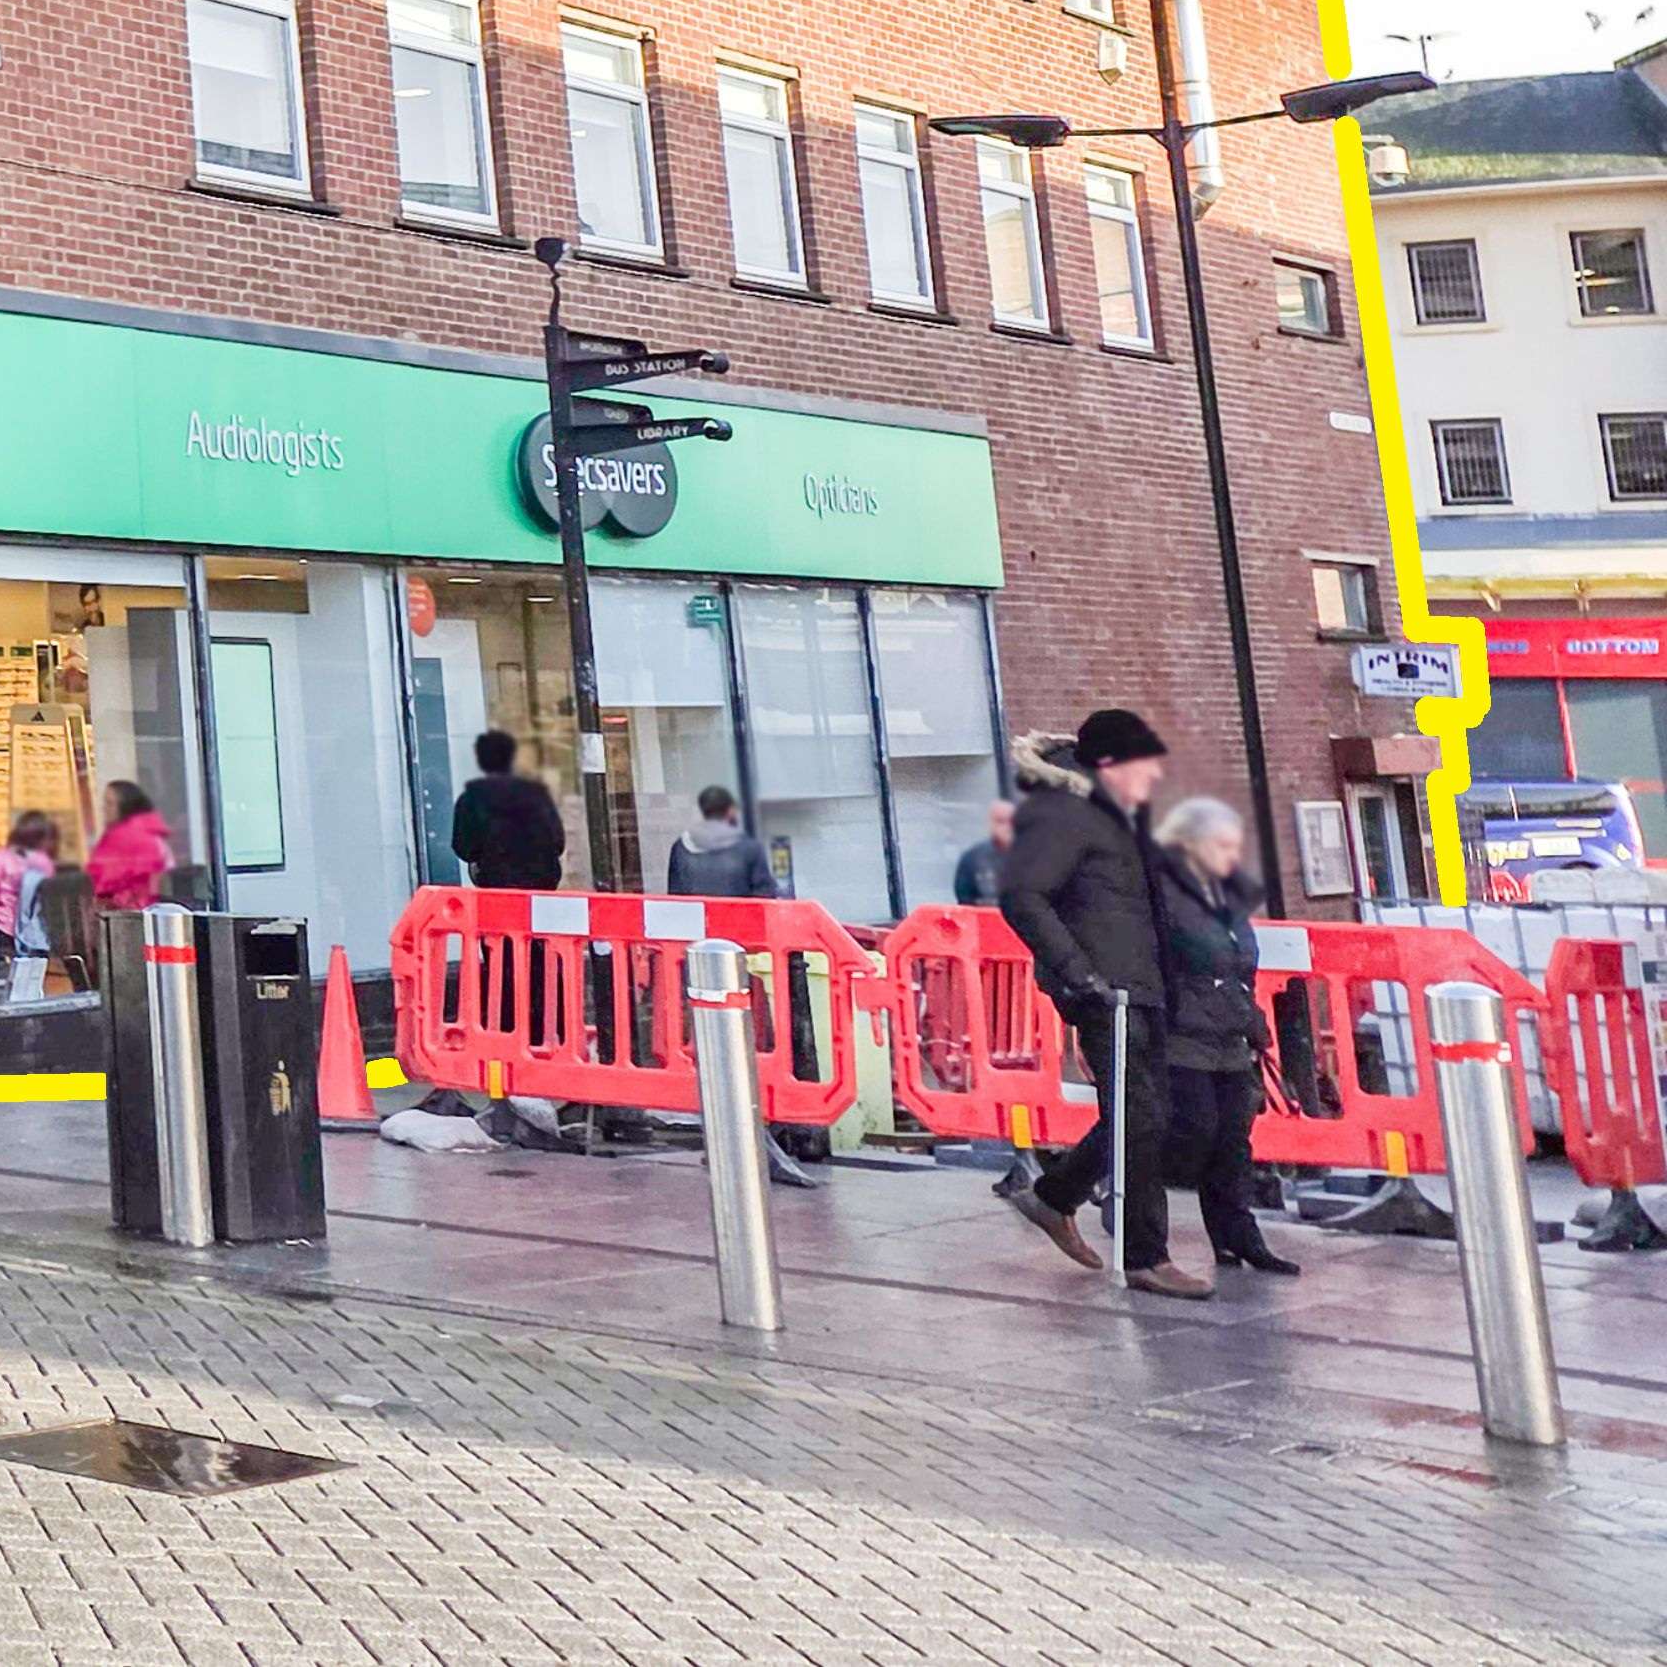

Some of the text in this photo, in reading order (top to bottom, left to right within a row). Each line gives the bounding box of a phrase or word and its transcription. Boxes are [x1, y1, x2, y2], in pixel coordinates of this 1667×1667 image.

[604, 359, 686, 376] BUS STATION
[187, 410, 344, 477] Audiologists
[637, 426, 689, 441] LIBRARY
[542, 444, 666, 496] Secsavers
[803, 472, 878, 521] Opticians
